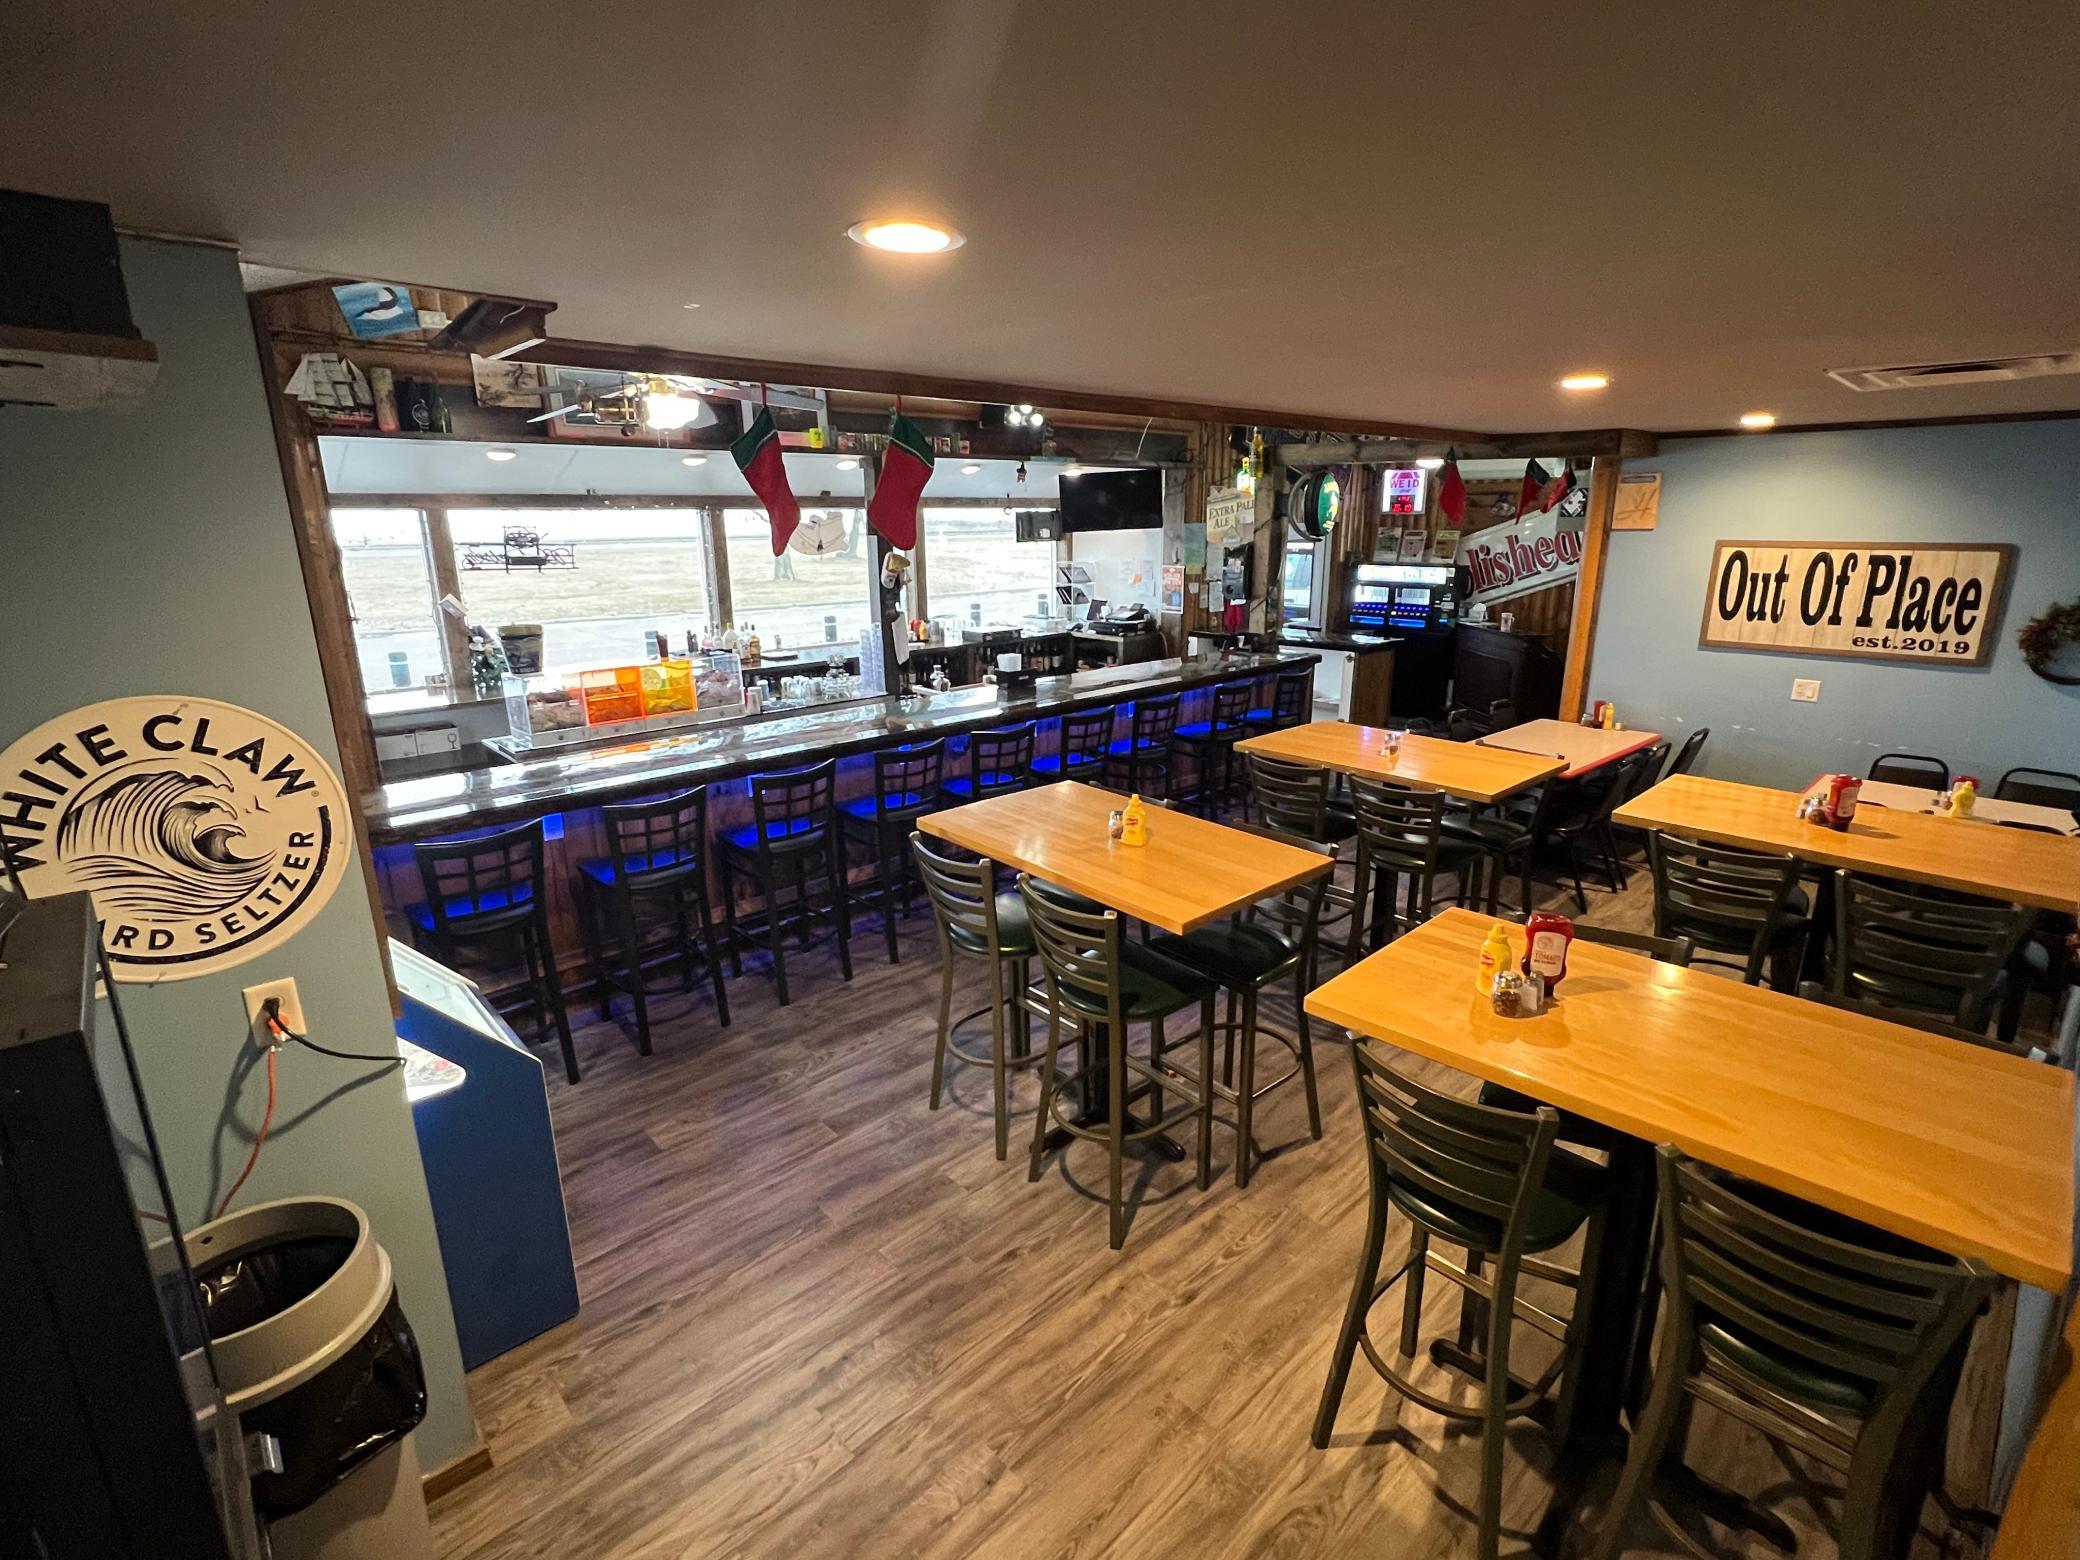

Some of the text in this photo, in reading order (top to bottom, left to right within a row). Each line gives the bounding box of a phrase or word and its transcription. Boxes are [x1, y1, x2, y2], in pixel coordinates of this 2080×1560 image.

[1209, 505, 1234, 521] EXTRA
[1213, 516, 1230, 529] ALE
[1719, 550, 1983, 635] Out Of Place
[0, 714, 317, 877] WHITE CLAW
[194, 831, 315, 945] SELTZER
